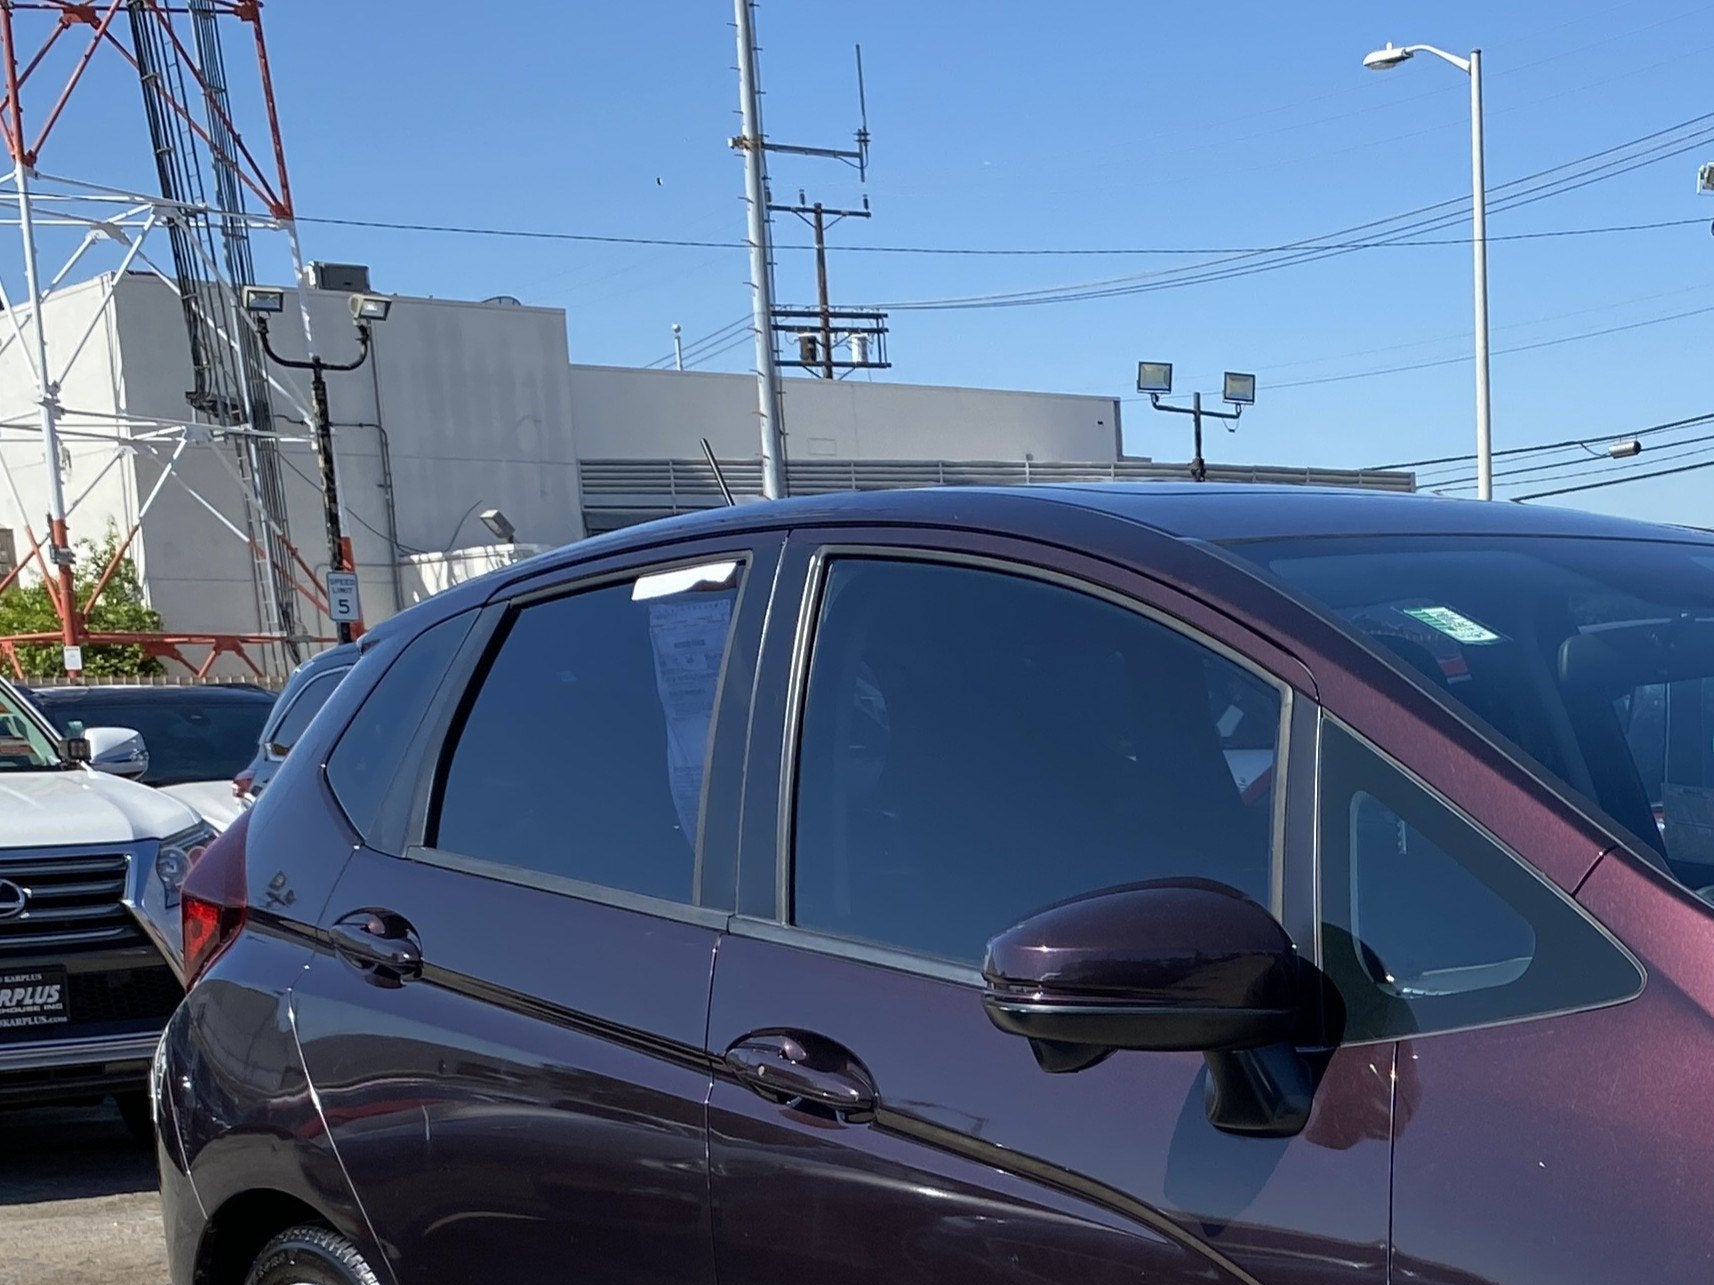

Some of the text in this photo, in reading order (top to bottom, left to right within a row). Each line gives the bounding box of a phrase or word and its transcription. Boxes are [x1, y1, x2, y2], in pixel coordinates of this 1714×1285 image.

[339, 599, 350, 615] 5
[0, 984, 61, 1007] RPLUS
[0, 1005, 40, 1013] HOUSE
